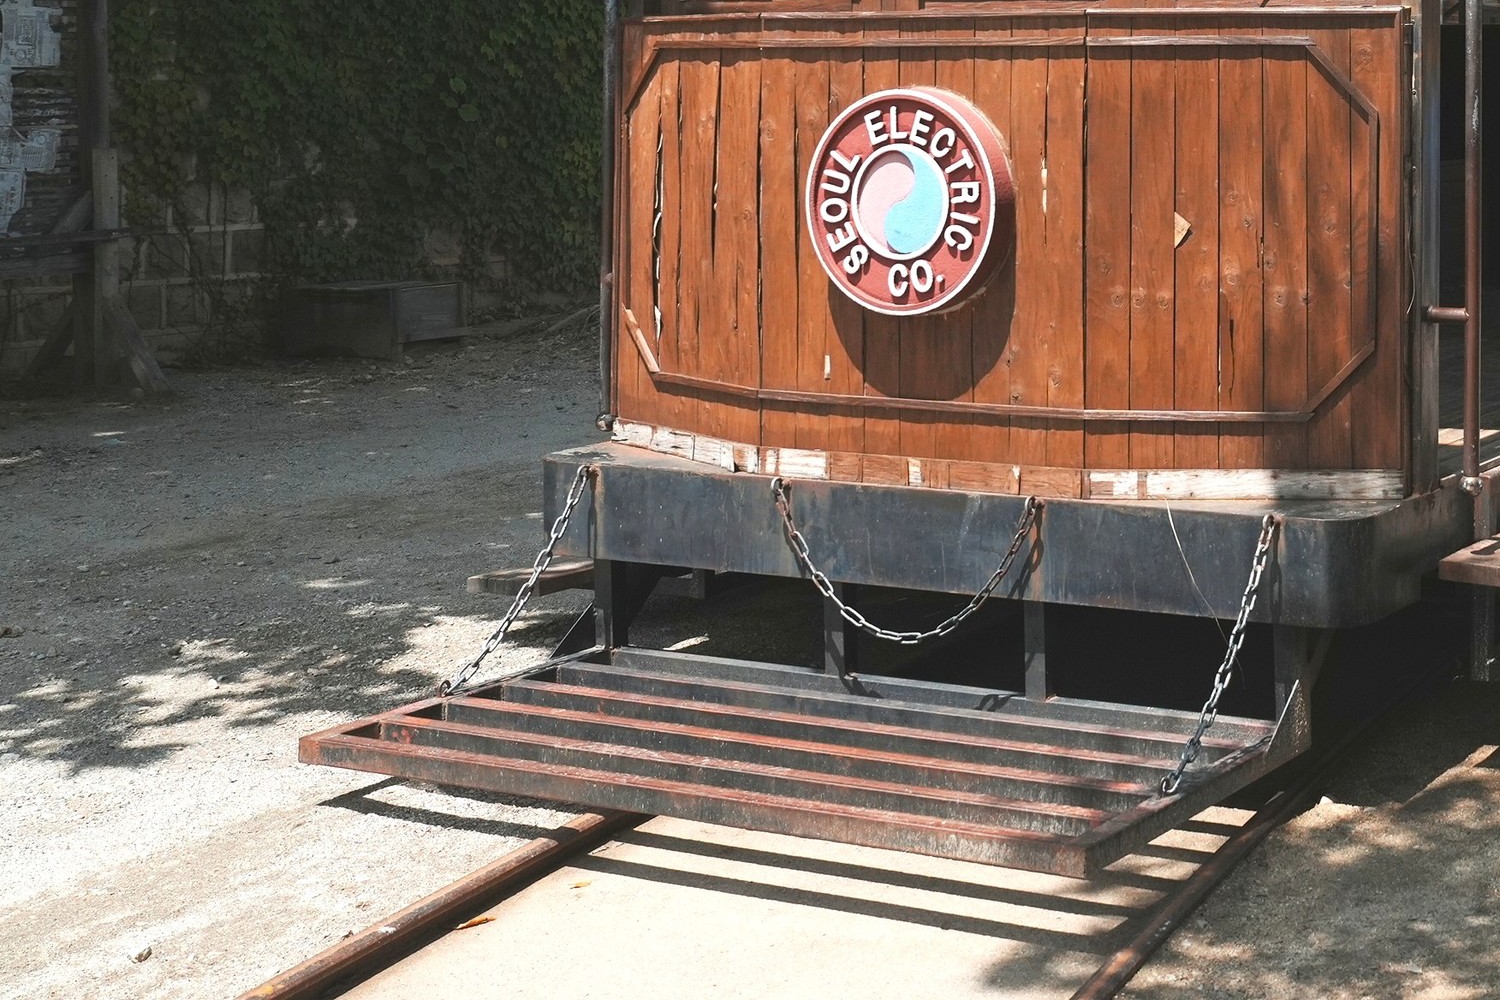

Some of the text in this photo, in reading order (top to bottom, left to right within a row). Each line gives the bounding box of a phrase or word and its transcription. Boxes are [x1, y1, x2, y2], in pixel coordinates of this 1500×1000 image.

[819, 105, 982, 298] SEOUL ELECTRIC CO.
